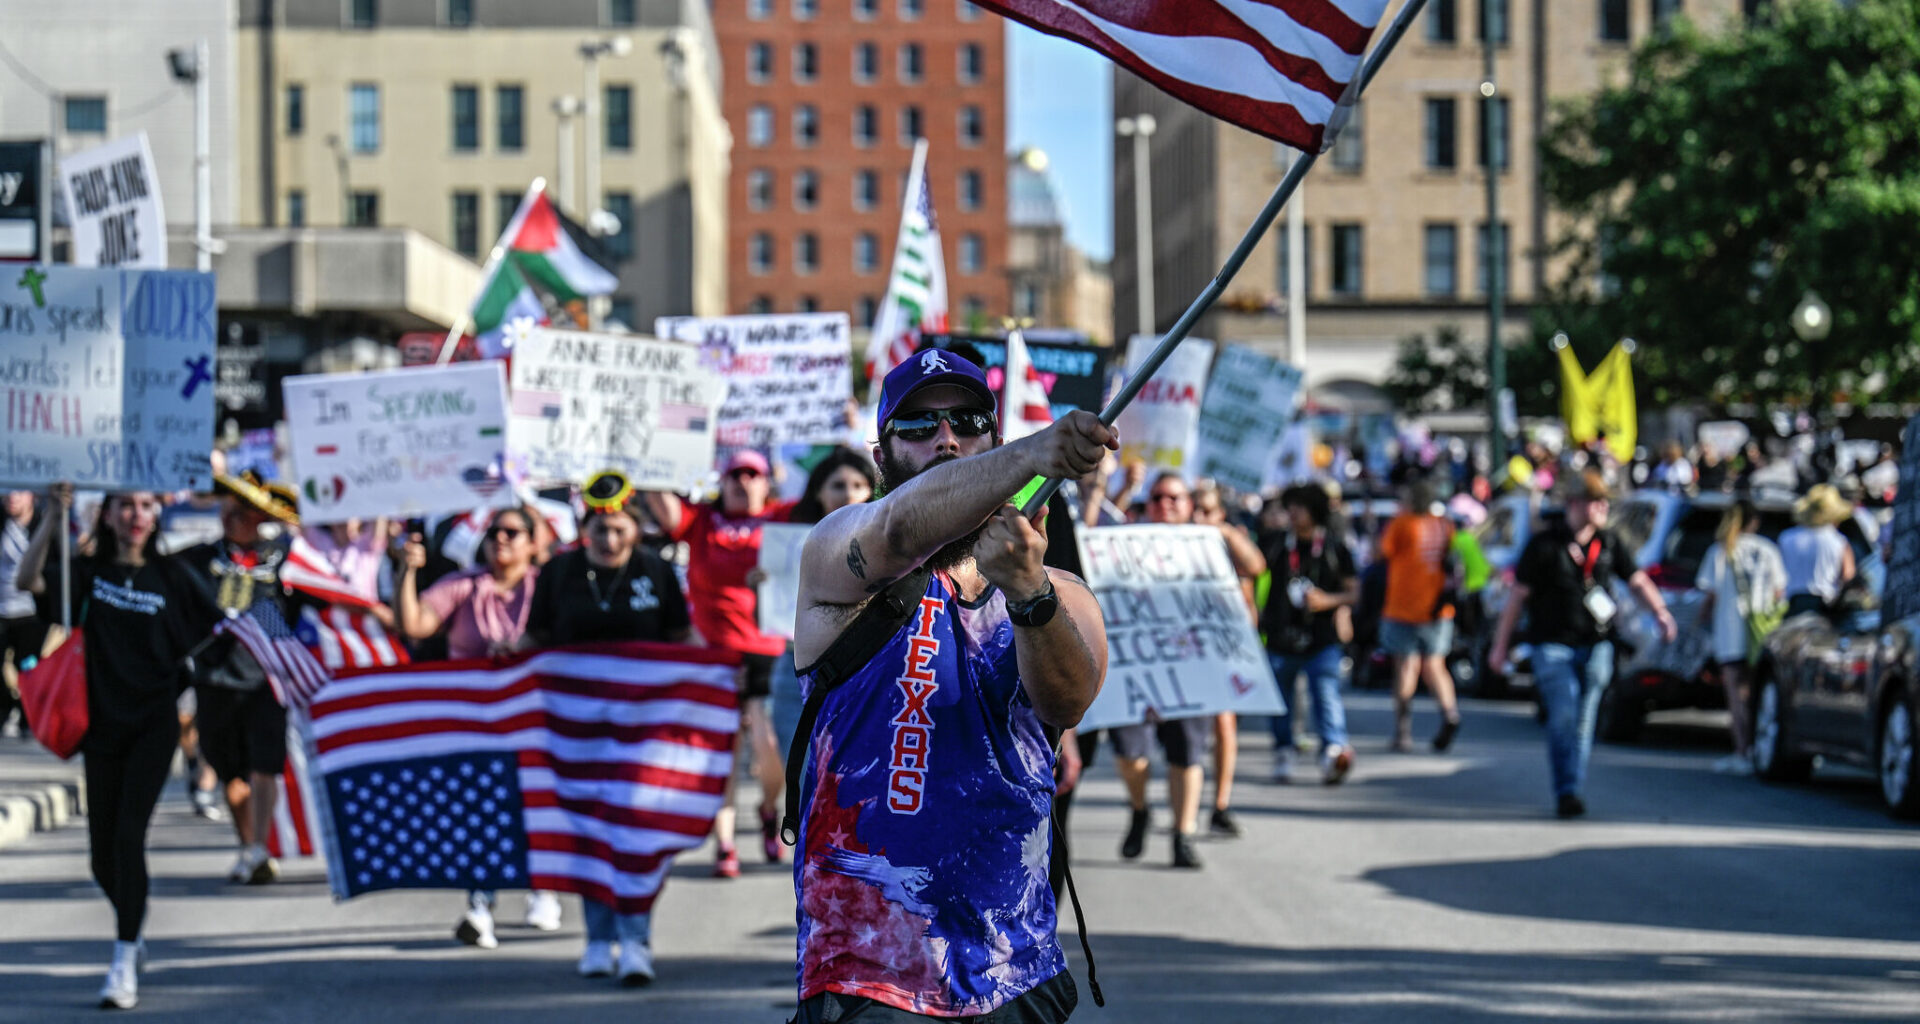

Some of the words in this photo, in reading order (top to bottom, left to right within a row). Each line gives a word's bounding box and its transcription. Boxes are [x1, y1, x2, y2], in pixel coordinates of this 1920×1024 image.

[0, 302, 36, 336] ns
[47, 285, 112, 345] speak
[85, 347, 118, 388] let
[131, 365, 181, 398] your
[547, 336, 607, 366] ANNE
[612, 343, 686, 375] FRANK
[366, 384, 477, 423] SPEAKING
[590, 371, 649, 399] ABOUT
[655, 375, 702, 404] THIS
[2, 385, 83, 437] TEACH
[94, 411, 142, 434] and
[153, 412, 204, 442] your
[602, 397, 649, 425] HER
[547, 415, 655, 458] DIARY
[75, 438, 166, 488] SPEAK
[1094, 584, 1180, 628] IRL
[1189, 622, 1257, 665] FOR
[887, 596, 944, 816] TEXAS
[1124, 665, 1204, 718] ALL
